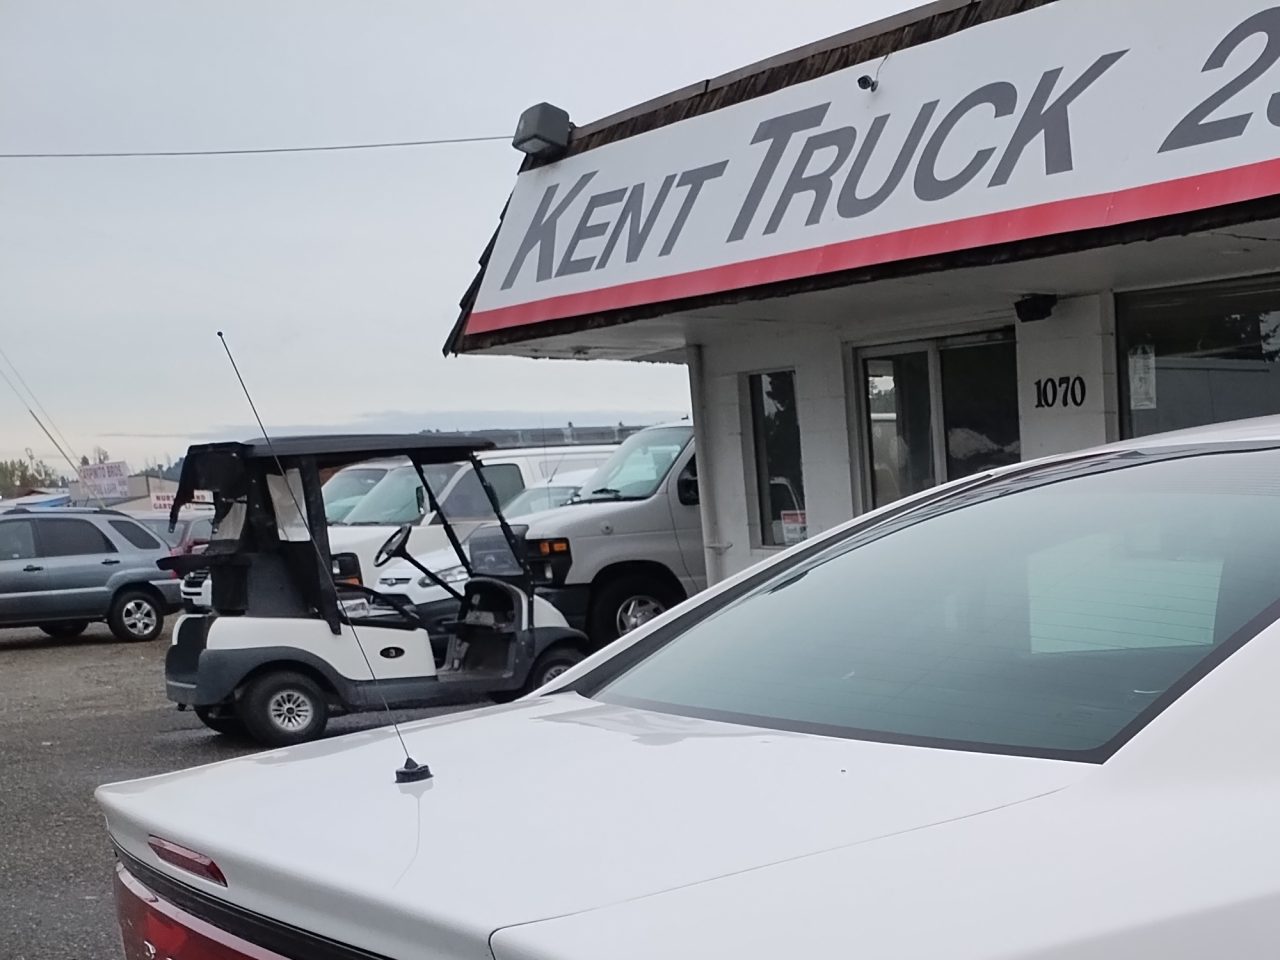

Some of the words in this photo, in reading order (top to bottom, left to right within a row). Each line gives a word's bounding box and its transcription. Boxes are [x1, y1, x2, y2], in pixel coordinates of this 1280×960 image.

[500, 159, 730, 291] KENT
[725, 49, 1130, 243] TRUCK
[1033, 376, 1086, 408] 1070
